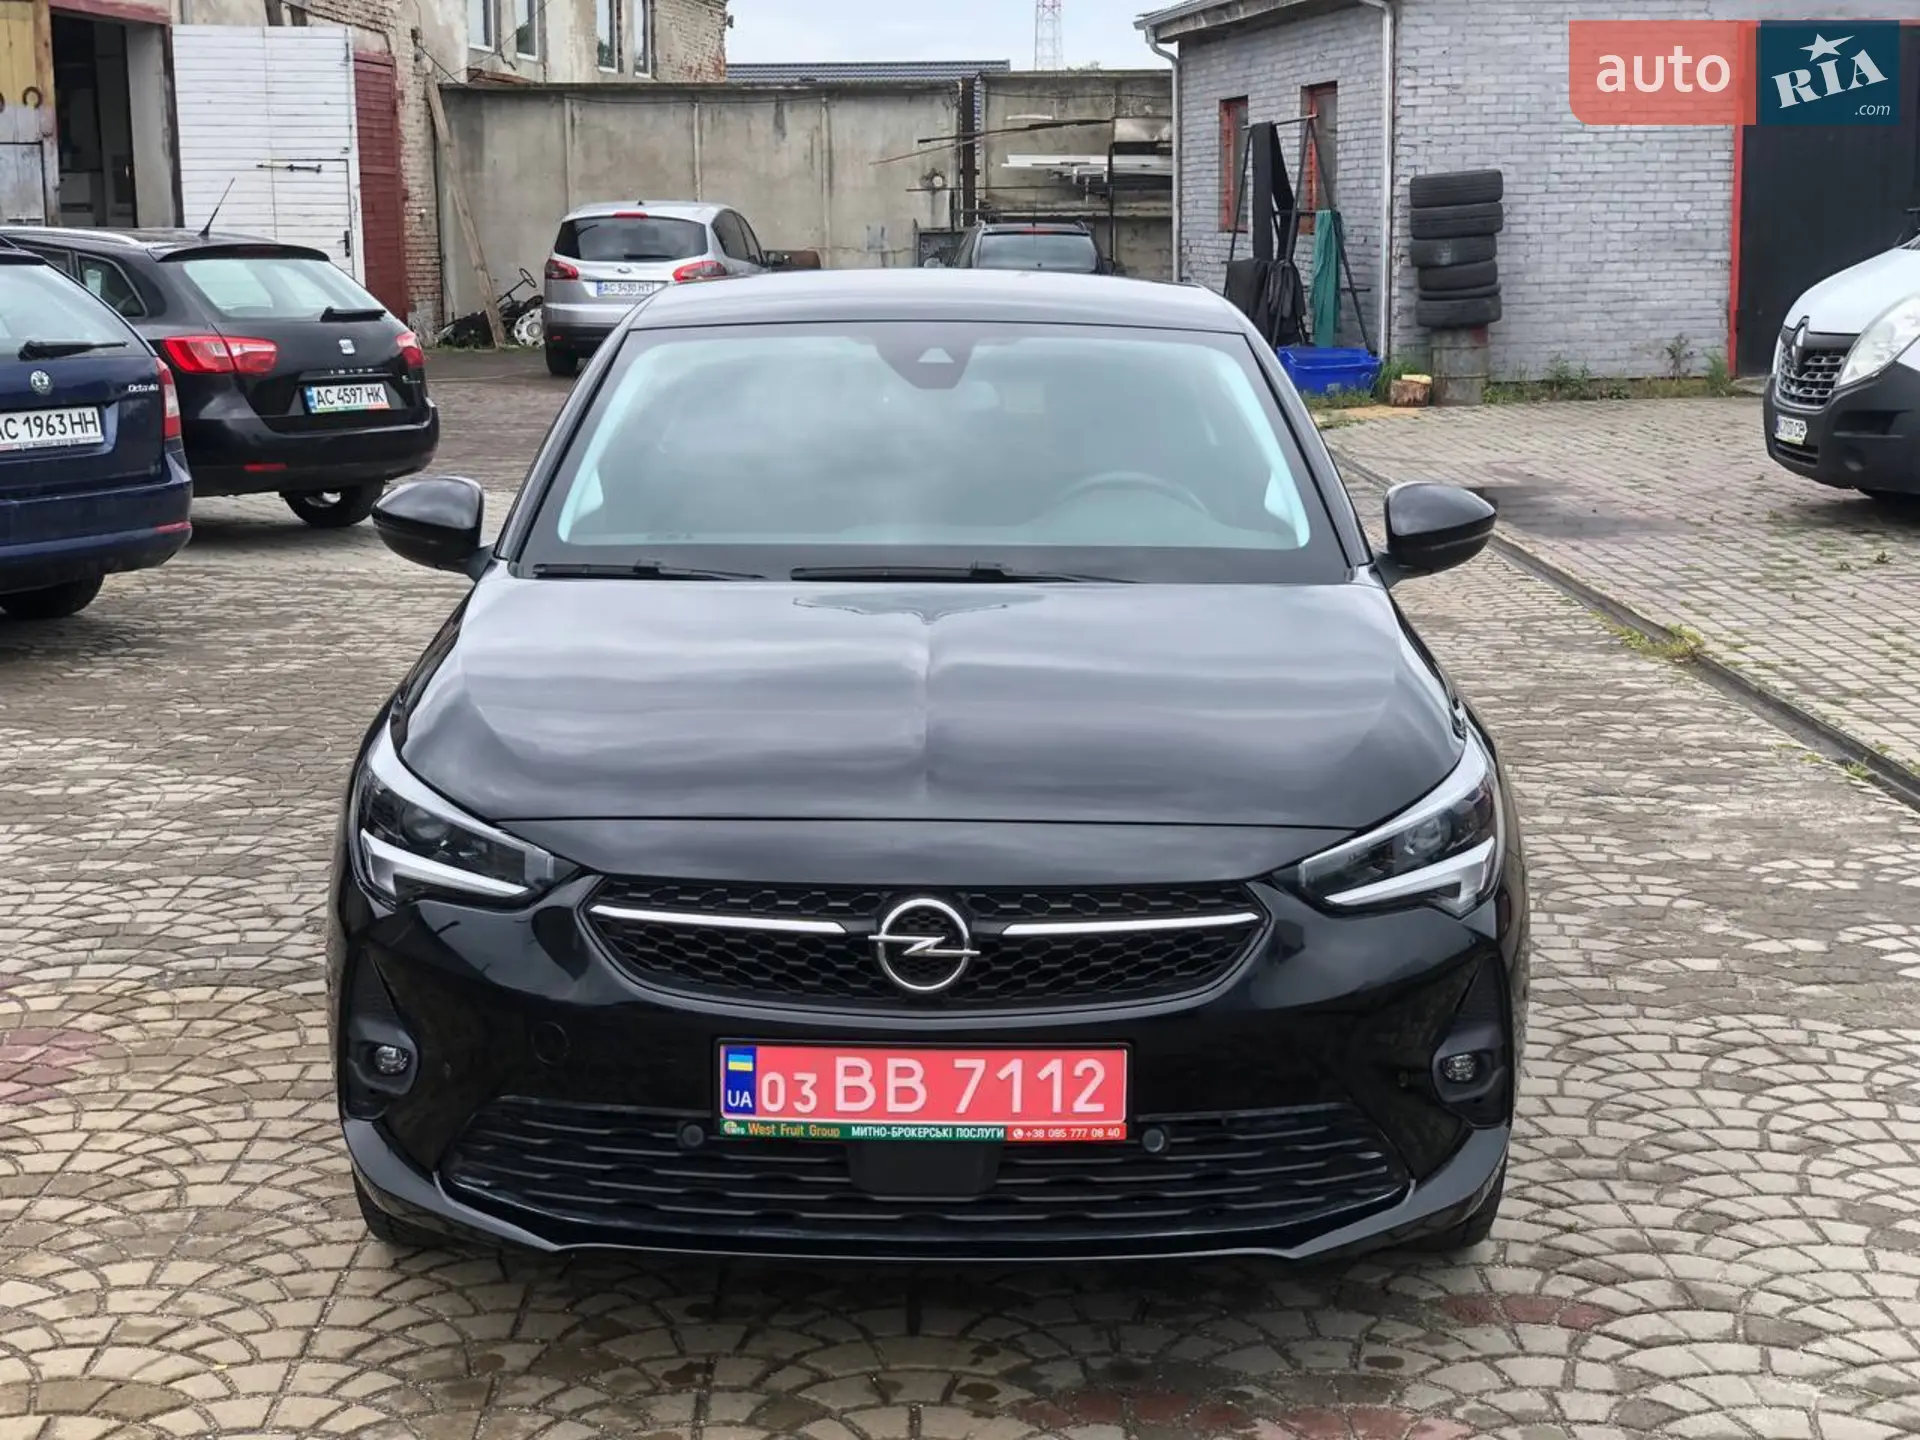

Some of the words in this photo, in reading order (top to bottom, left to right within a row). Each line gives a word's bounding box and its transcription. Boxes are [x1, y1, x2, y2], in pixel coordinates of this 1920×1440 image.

[316, 388, 335, 406] AC
[336, 387, 362, 405] 4597
[366, 384, 385, 403] HK
[23, 414, 67, 438] 1963
[69, 411, 98, 434] HH
[727, 1090, 753, 1108] UA
[761, 1071, 818, 1114] 03
[834, 1056, 927, 1113] BB
[954, 1058, 1106, 1114] 7112
[747, 1122, 776, 1136] West
[780, 1122, 804, 1136] Fruit
[808, 1124, 841, 1138] Group
[851, 1125, 952, 1139] МИТНО-БРОКЕРСЬКІ
[956, 1127, 1005, 1139] ПОСЛУГИ
[1025, 1128, 1045, 1138] +38
[1070, 1127, 1088, 1138] 777
